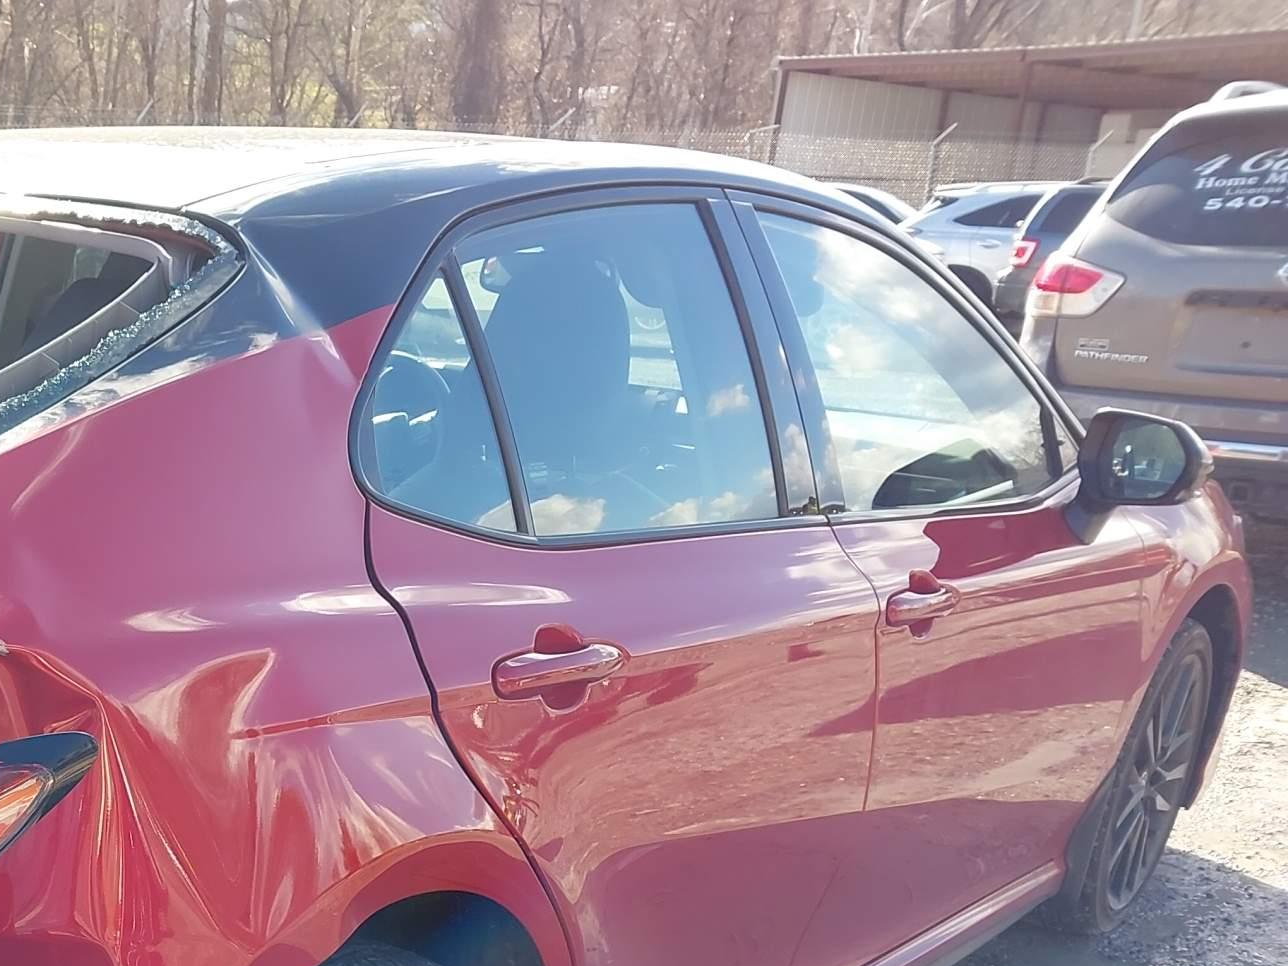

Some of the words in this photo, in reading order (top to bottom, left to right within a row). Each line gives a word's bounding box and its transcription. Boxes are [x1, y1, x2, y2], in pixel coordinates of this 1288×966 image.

[1195, 176, 1259, 190] Home
[1203, 195, 1288, 210] 540-
[1074, 350, 1149, 363] PATHFINDER
